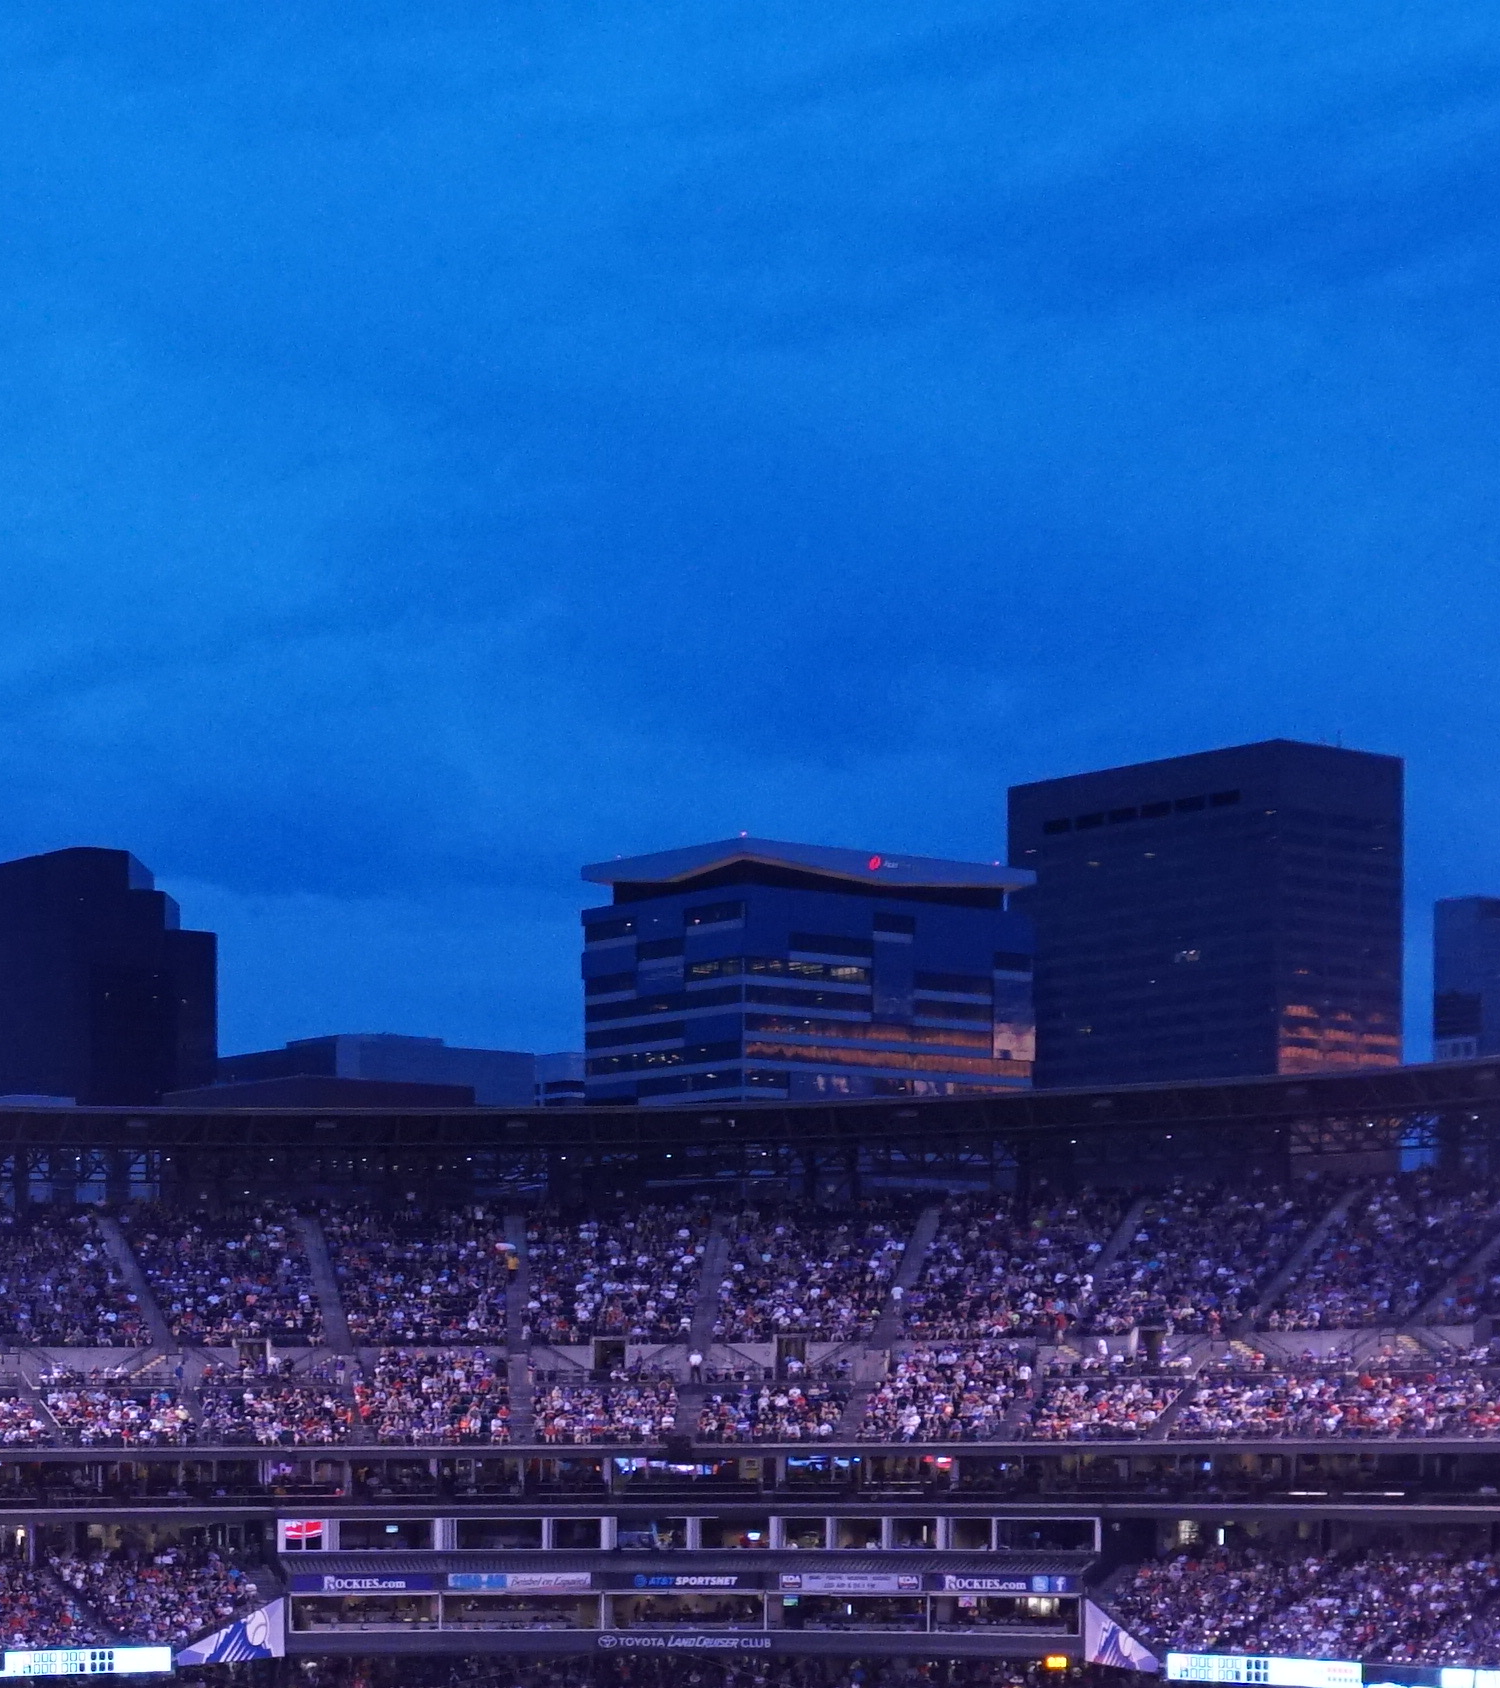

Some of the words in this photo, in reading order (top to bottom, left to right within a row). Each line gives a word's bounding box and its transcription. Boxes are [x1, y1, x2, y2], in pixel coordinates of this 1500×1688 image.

[323, 1575, 406, 1590] ROCKIES.com
[675, 1576, 738, 1586] SPORTSNET
[945, 1575, 1027, 1590] ROCKIES.com
[619, 1637, 665, 1647] TOYOTA
[740, 1637, 771, 1648] CLUB
